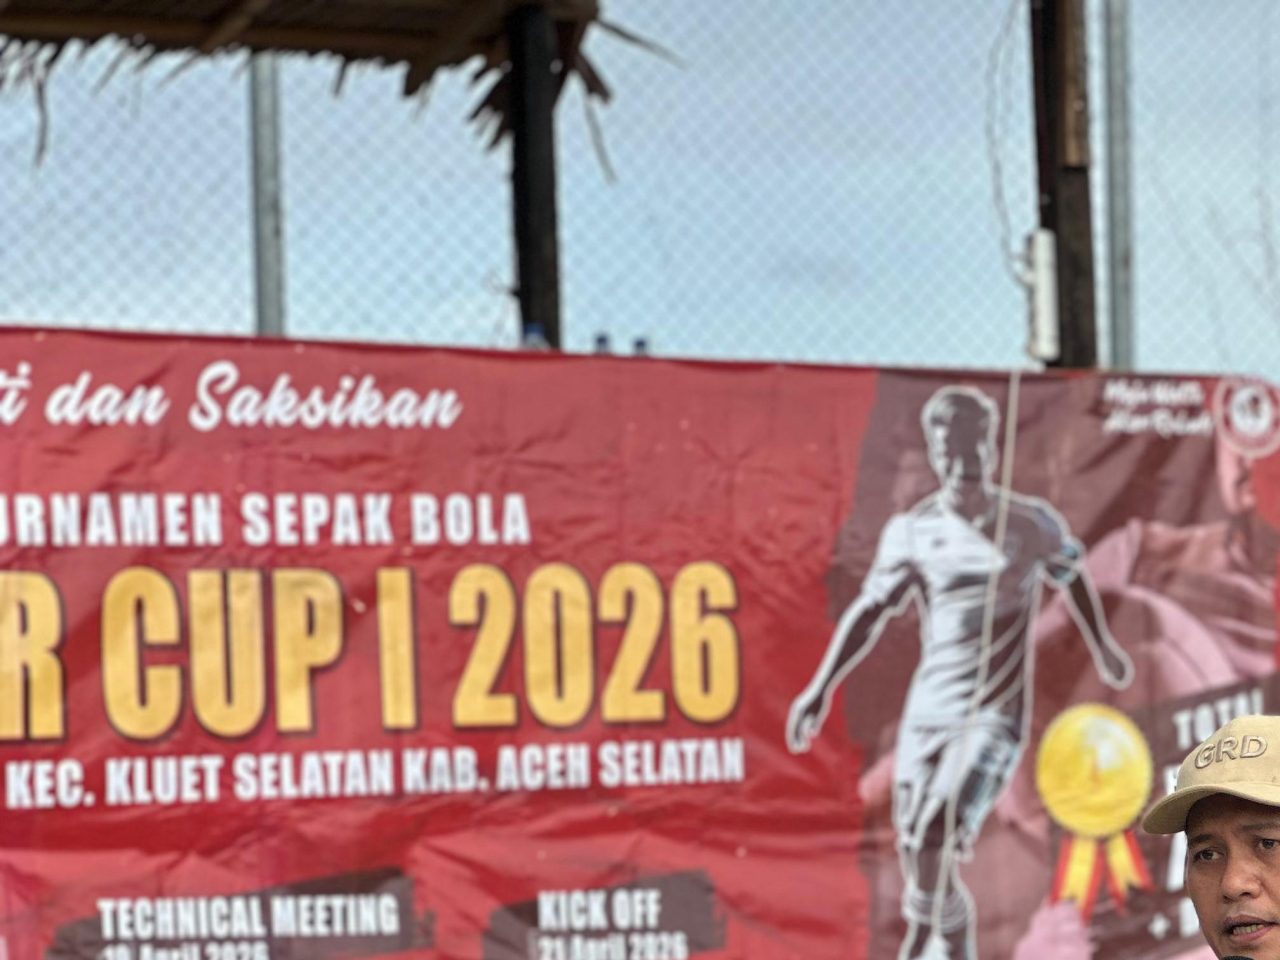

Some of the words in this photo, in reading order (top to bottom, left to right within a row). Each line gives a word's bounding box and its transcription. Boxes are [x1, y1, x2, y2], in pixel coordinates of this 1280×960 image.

[45, 370, 171, 426] dan
[188, 360, 463, 432] Saksikan
[241, 493, 394, 546] SEPAK
[411, 493, 531, 546] BOLA
[102, 566, 344, 740] CUP
[376, 568, 418, 729] I
[448, 561, 743, 729] 2026
[5, 758, 95, 808] KEC.
[105, 754, 224, 805] KLUET
[232, 749, 394, 799] SELATAN
[402, 747, 489, 793] KAB.
[496, 743, 590, 790] ACEH
[598, 737, 744, 788] SELATAN
[1194, 734, 1268, 769] GRD
[97, 895, 266, 939] TECHNICAL
[271, 893, 399, 936] MEETING
[537, 889, 608, 931] KICK
[612, 887, 661, 929] OFF
